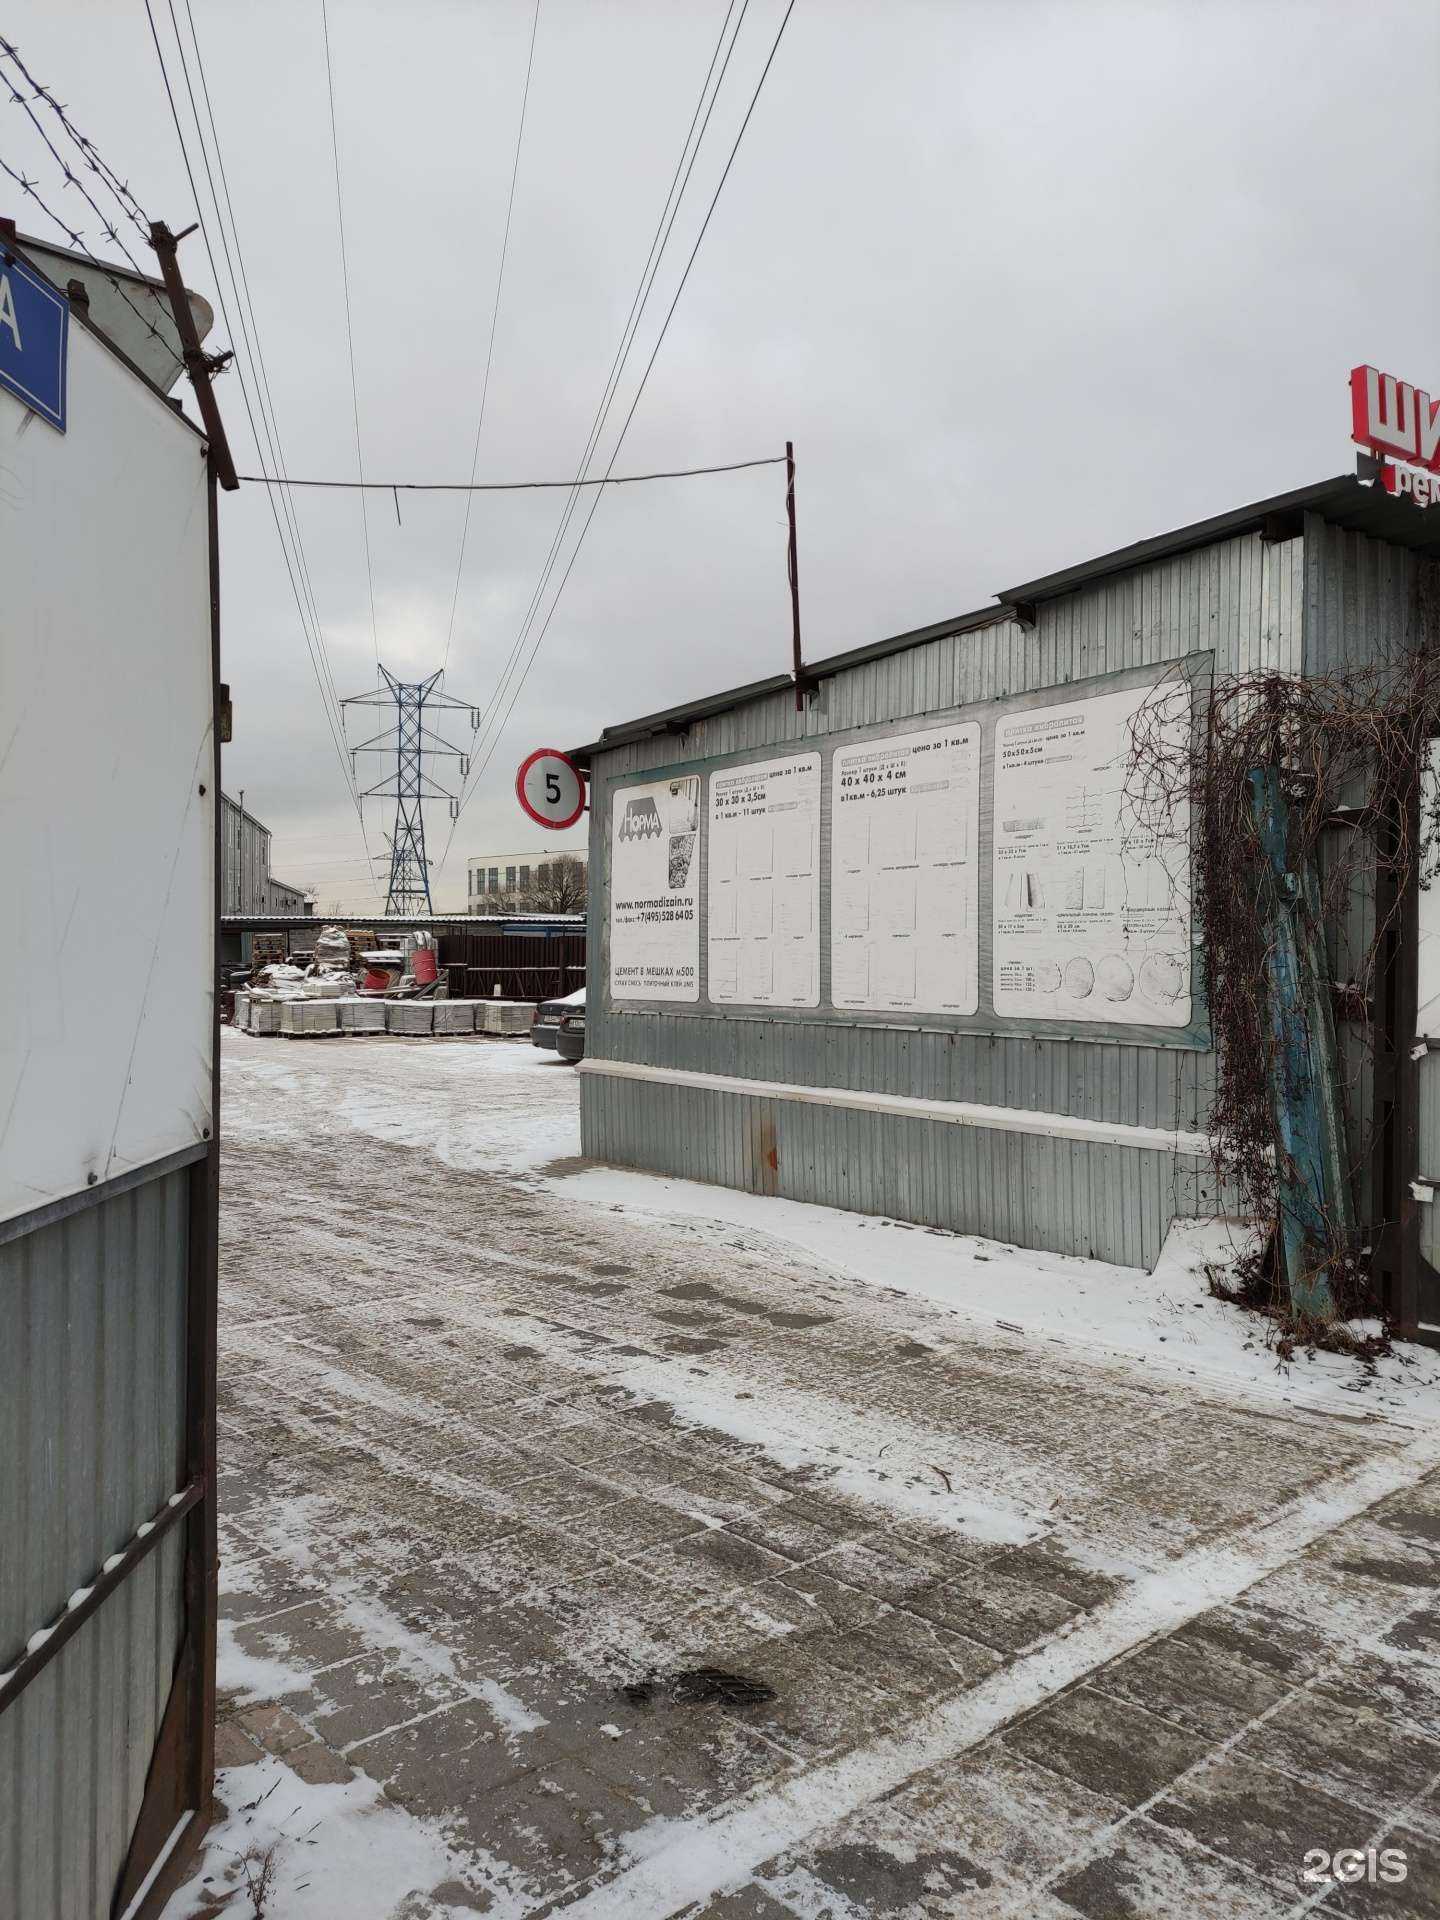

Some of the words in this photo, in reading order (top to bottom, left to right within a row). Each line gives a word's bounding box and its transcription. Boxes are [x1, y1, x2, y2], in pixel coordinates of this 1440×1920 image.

[912, 745, 930, 753] цена
[951, 738, 968, 746] кв.м
[841, 777, 852, 787] 40
[863, 774, 874, 784] 40
[887, 770, 892, 780] 4
[895, 770, 906, 778] см
[546, 773, 561, 804] 5
[871, 788, 886, 799] 6,25
[888, 786, 907, 797] штук
[716, 798, 723, 807] 30
[731, 796, 739, 804] 30
[616, 896, 693, 910] www.normadizain.ru
[615, 967, 639, 976] ЦЕМЕНТ
[647, 967, 674, 975] МЕШКАХ
